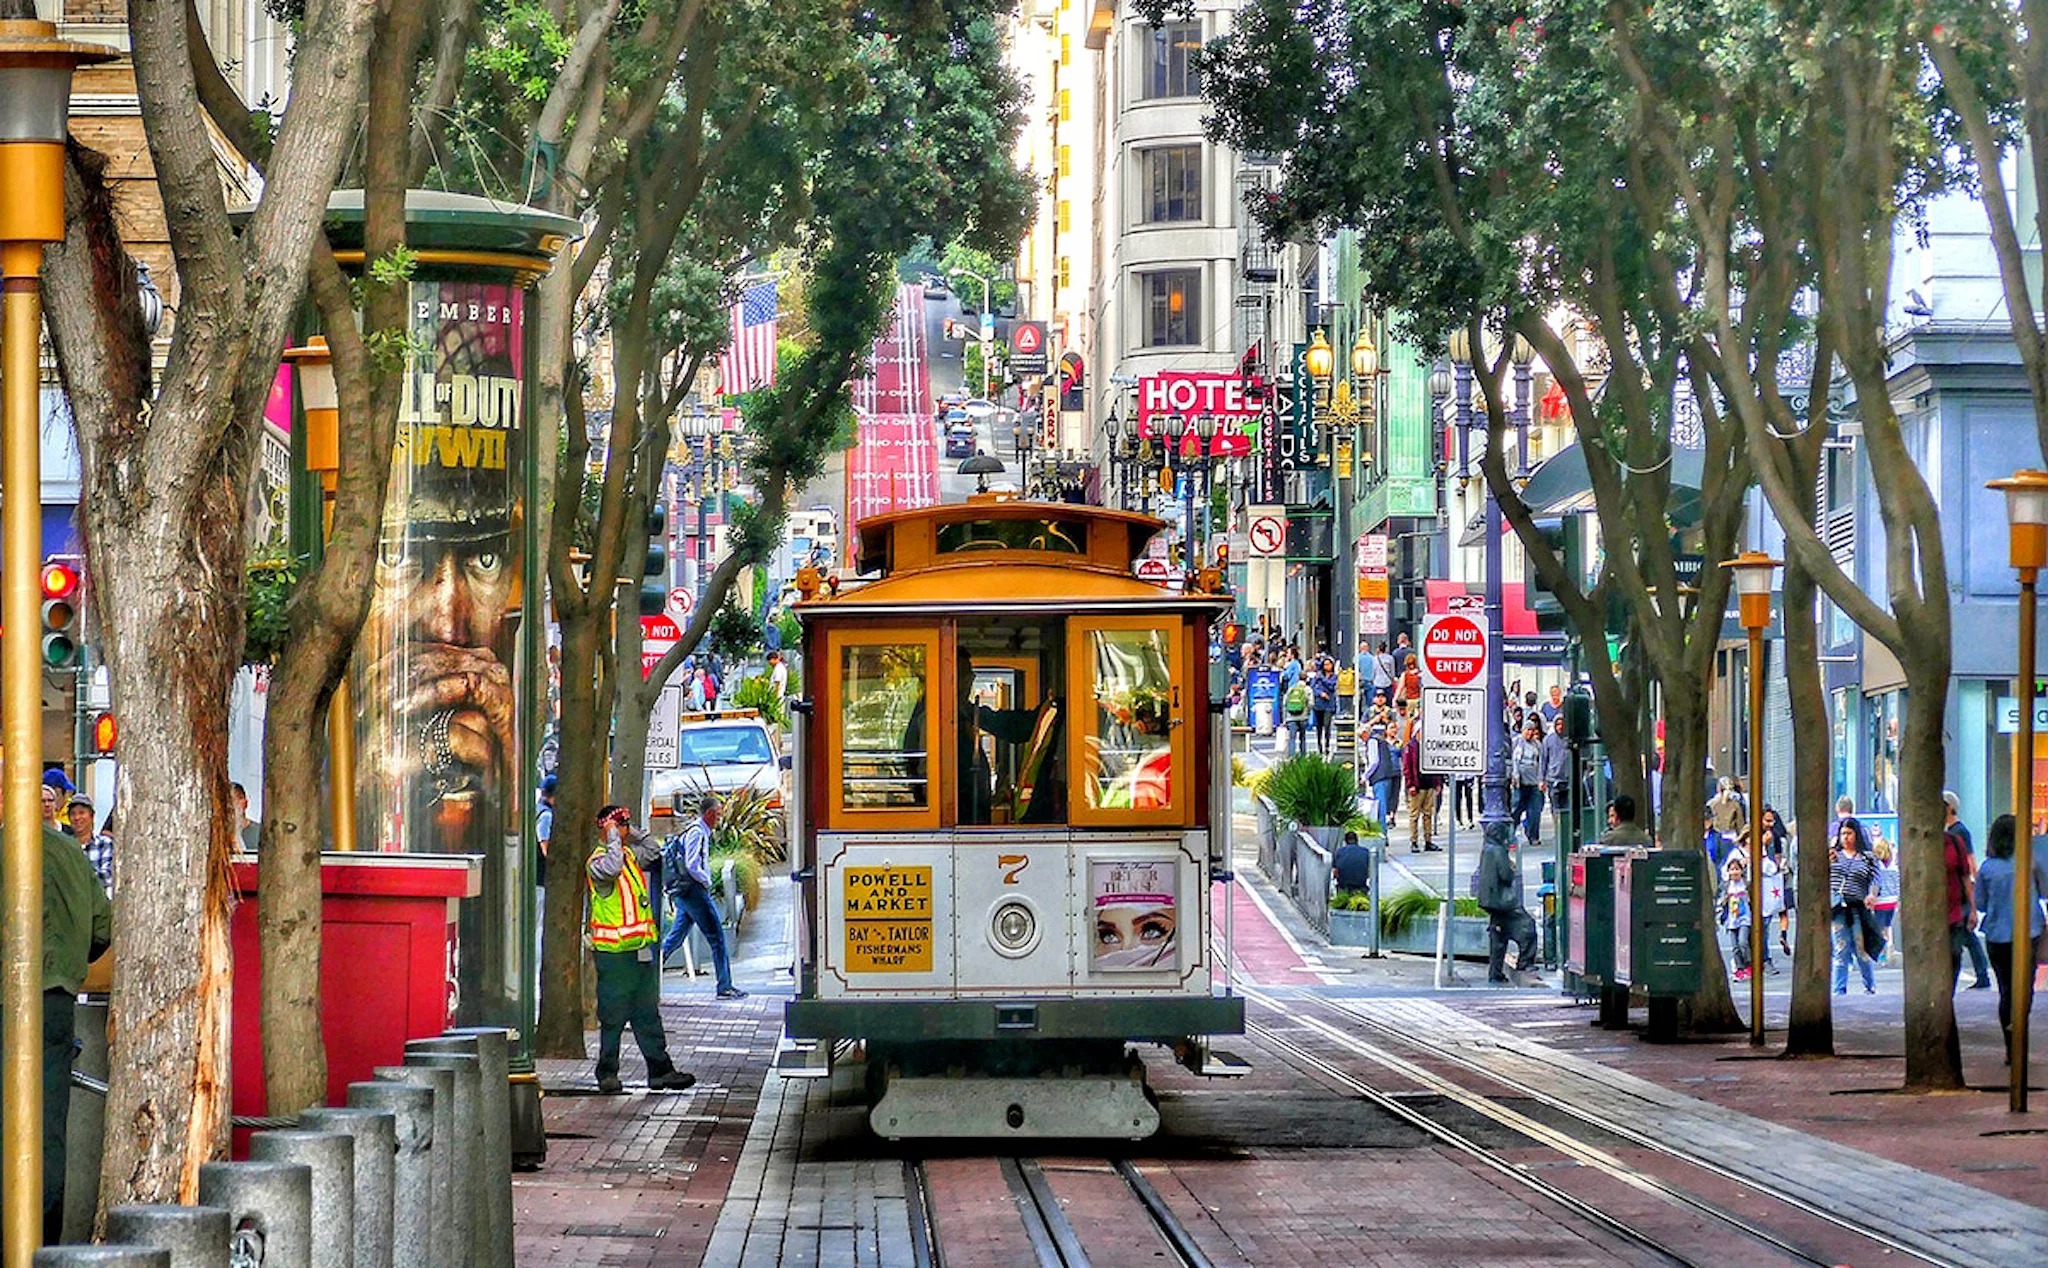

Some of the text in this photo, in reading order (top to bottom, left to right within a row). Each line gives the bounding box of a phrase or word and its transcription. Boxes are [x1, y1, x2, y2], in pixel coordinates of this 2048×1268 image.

[417, 301, 511, 324] EMBER
[398, 373, 442, 423] LL
[436, 382, 452, 402] OF
[1145, 379, 1262, 411] HOTEL
[1047, 399, 1055, 438] PARK
[1145, 413, 1260, 437] STAFOR
[1263, 405, 1274, 502] COCKTAILS
[652, 626, 676, 638] NOT
[1433, 629, 1478, 642] DO NOT
[1436, 660, 1473, 673] ENTER
[1436, 693, 1471, 704] EXCEPT
[1442, 709, 1466, 719] MUNI
[1440, 725, 1468, 735] TAXIS
[1425, 739, 1480, 751] COMMERCIAL
[1430, 755, 1477, 768] VEHICLES
[996, 854, 1029, 884] 7
[849, 873, 927, 887] POWELL
[870, 887, 908, 897] AND
[847, 898, 928, 911] MARKET
[849, 927, 869, 941] BAY
[888, 926, 929, 941] TAYLOR
[856, 944, 922, 955] FISHERMANS
[871, 956, 905, 965] WHARF
